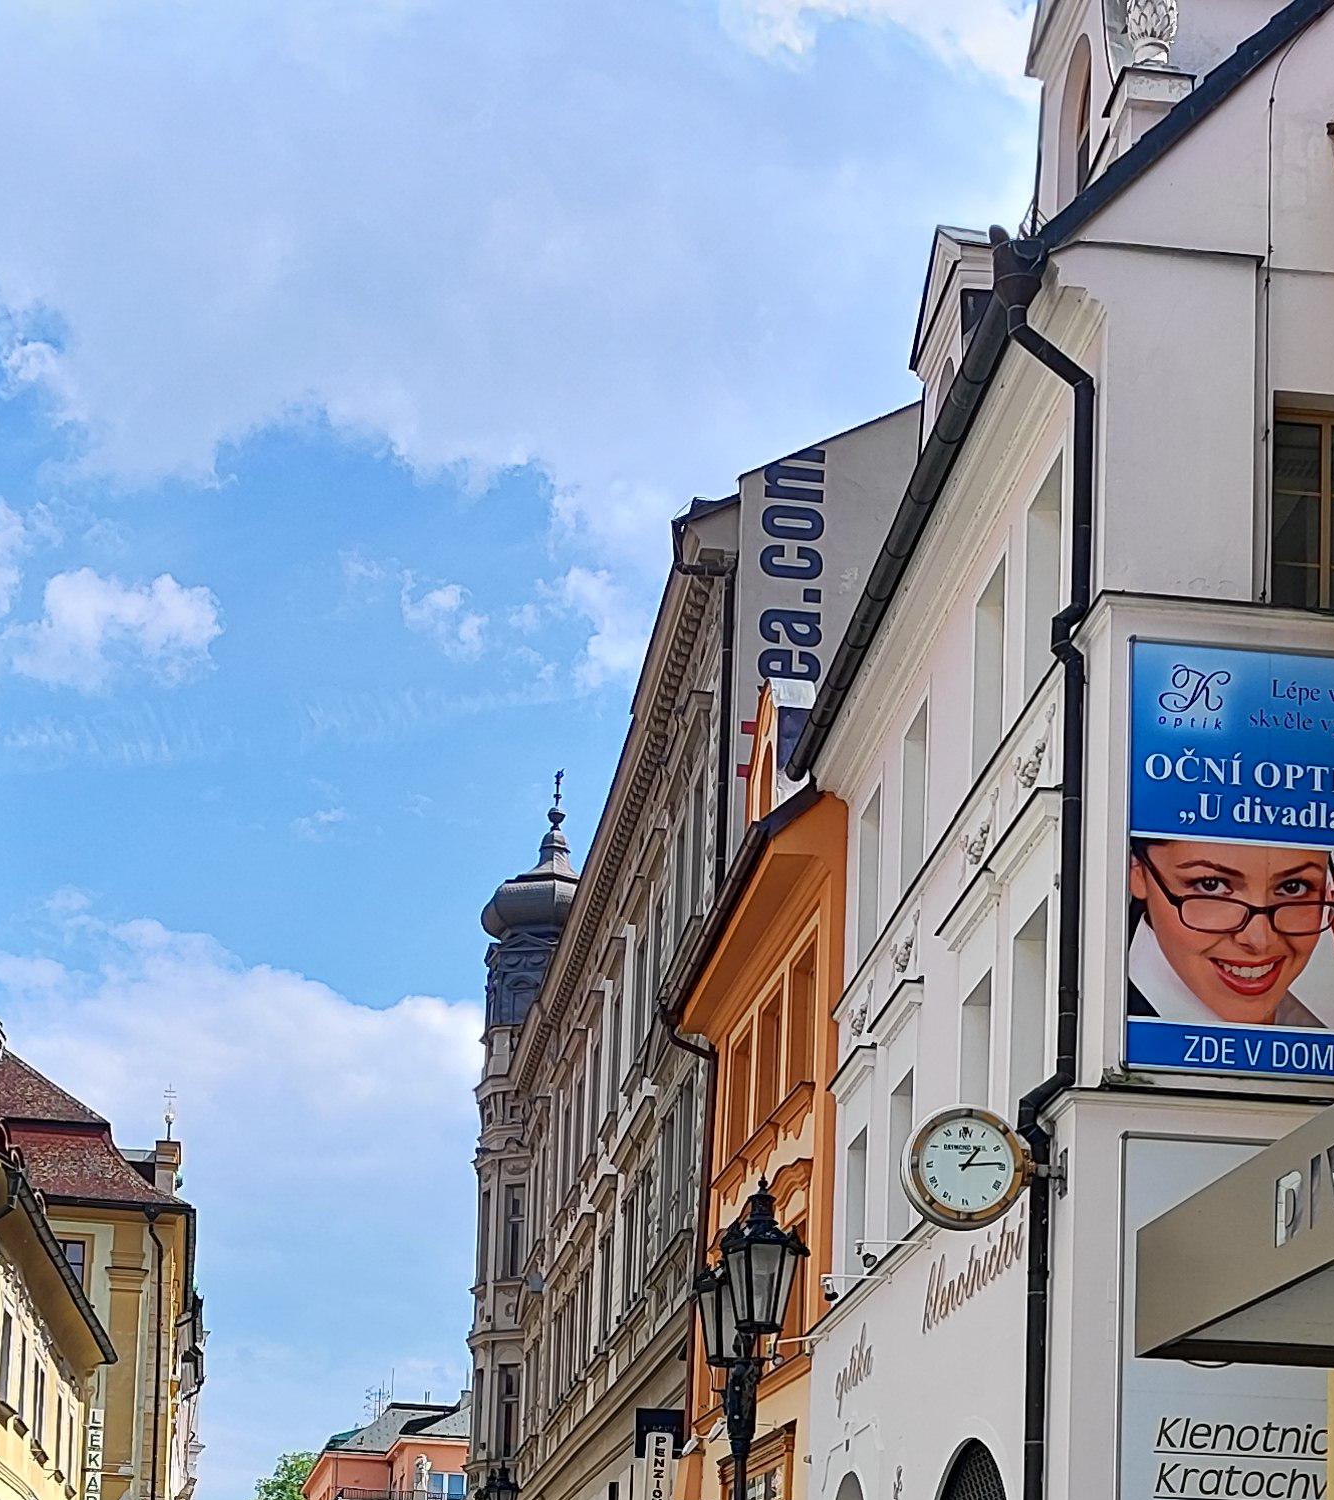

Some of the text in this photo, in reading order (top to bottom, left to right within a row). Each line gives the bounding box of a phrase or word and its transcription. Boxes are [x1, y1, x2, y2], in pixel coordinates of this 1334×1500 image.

[1272, 679, 1320, 706] Lépe
[1158, 714, 1223, 731] optik
[1249, 709, 1313, 731] skvěle
[1144, 747, 1242, 787] OČNÍ
[1183, 1035, 1236, 1064] ZDE
[1244, 1038, 1263, 1066] V
[922, 1202, 1025, 1334] klenotnictví
[835, 1322, 874, 1418] optika
[1156, 1417, 1328, 1455] Klenotnic
[1155, 1462, 1328, 1500] Kratochv
